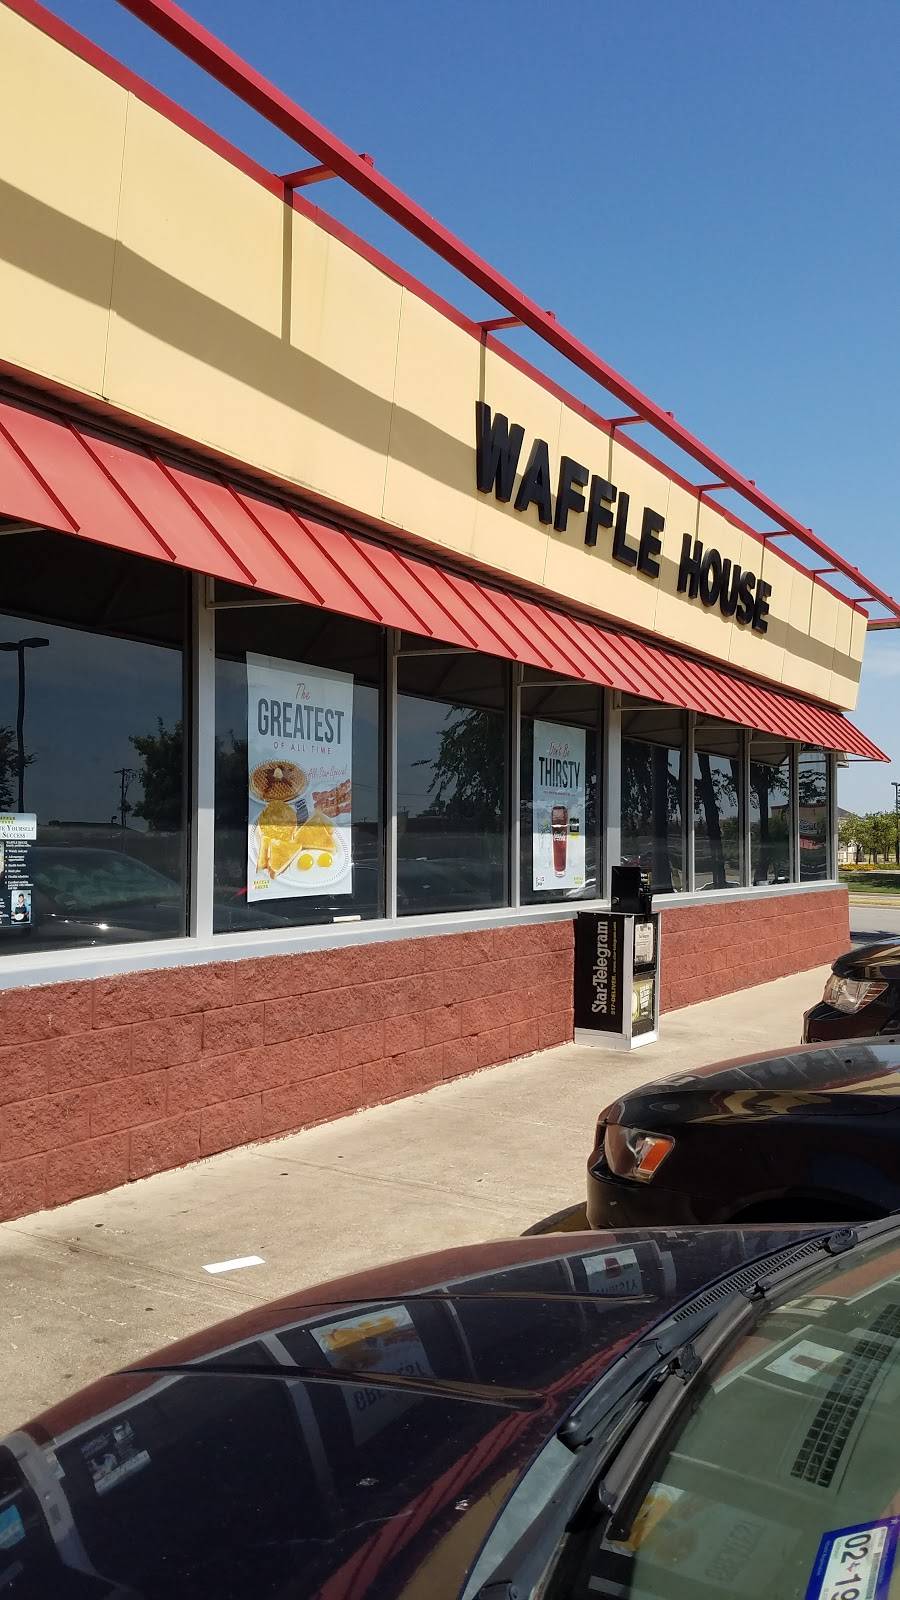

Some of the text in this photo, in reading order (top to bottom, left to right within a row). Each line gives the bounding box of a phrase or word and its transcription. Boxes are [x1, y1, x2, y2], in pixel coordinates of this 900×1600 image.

[475, 400, 772, 634] WAFFLE HOUSE
[296, 682, 310, 700] The
[258, 698, 344, 744] GREATEST
[273, 741, 332, 755] OF ALL TIME
[539, 756, 581, 789] THIRSTY
[592, 921, 610, 1014] Star-Telegram
